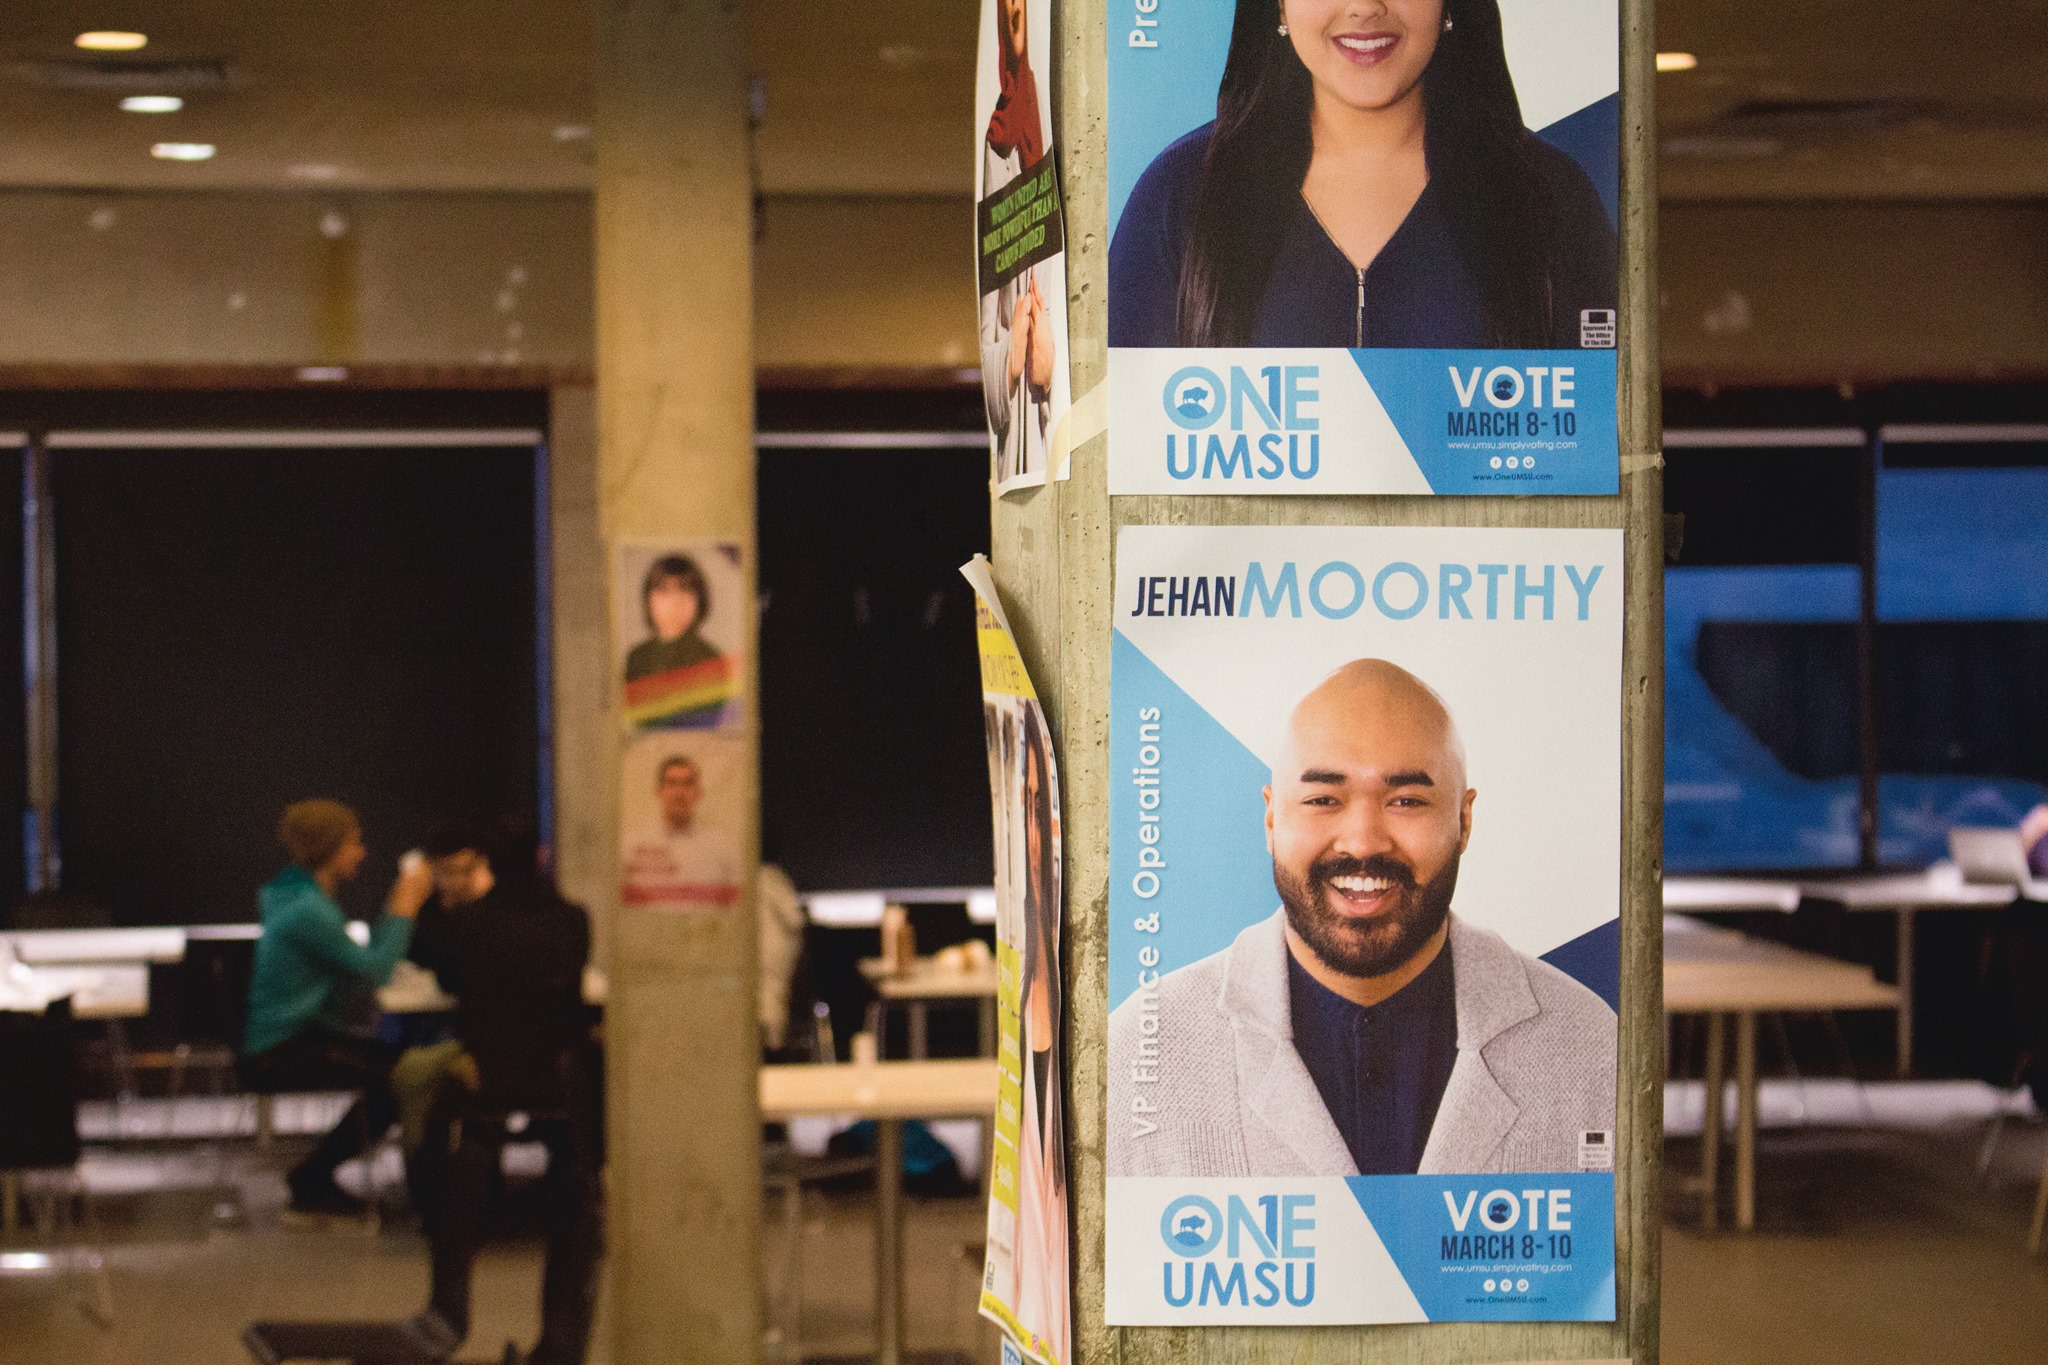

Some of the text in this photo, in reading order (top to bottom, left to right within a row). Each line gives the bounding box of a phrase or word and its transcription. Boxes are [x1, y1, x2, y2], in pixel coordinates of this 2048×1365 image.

[1448, 366, 1575, 409] VOTE
[1447, 440, 1578, 451] www.umsu.simplyvoting.com
[1448, 411, 1576, 437] MARCH 8-10
[1167, 433, 1319, 480] UMSU
[1473, 473, 1554, 481] www.OneUMSU.com
[1131, 560, 1605, 621] JEHAN MOORTHY
[1131, 707, 1166, 1139] VP Finance & Operations
[1443, 1189, 1572, 1232] VOTE
[1441, 1234, 1572, 1260] MARCH 8-10
[1441, 1263, 1573, 1274] www.umsu.simplyvoting.com
[1163, 1261, 1315, 1307] UMSU
